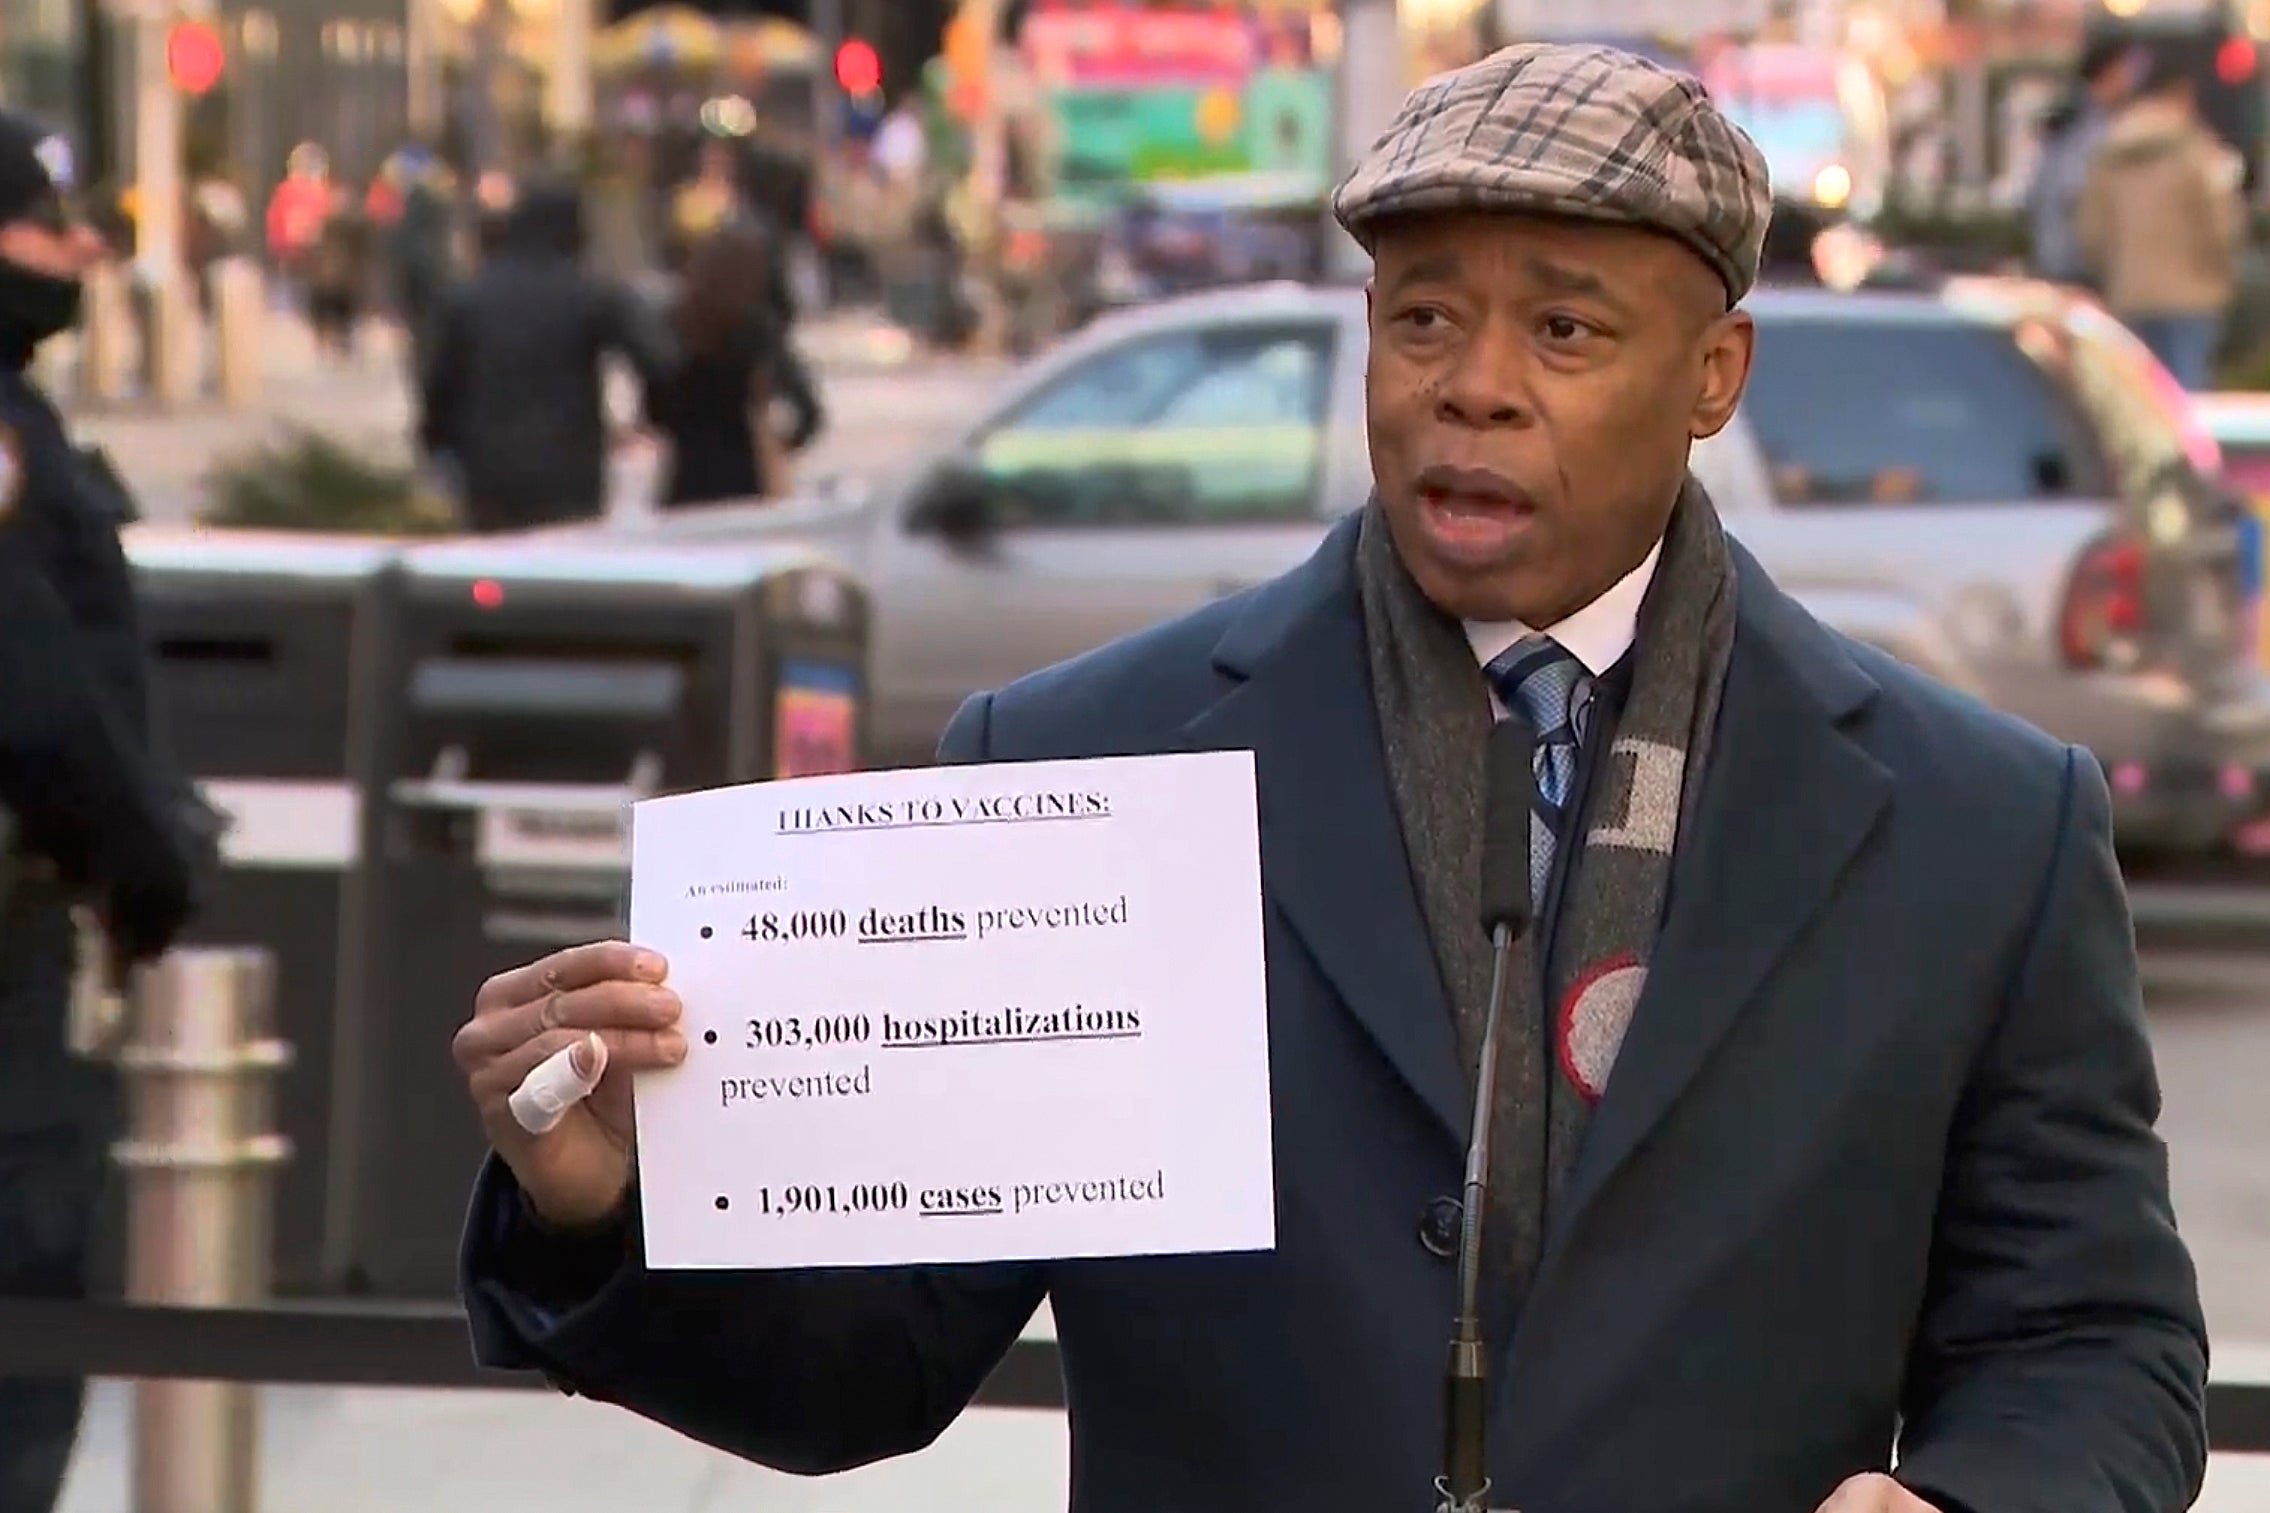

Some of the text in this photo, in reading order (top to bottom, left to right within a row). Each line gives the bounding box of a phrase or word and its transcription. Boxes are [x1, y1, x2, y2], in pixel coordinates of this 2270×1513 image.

[776, 792, 1110, 831] THANKS TO VACCINES:
[685, 876, 788, 898] An estimated:
[741, 895, 1129, 943] 48,000 deaths prevented
[744, 1004, 1142, 1052] 303,000 hospitalizations
[720, 1064, 871, 1107] prevented
[757, 1169, 1165, 1219] 1,901,000 cases prevented
